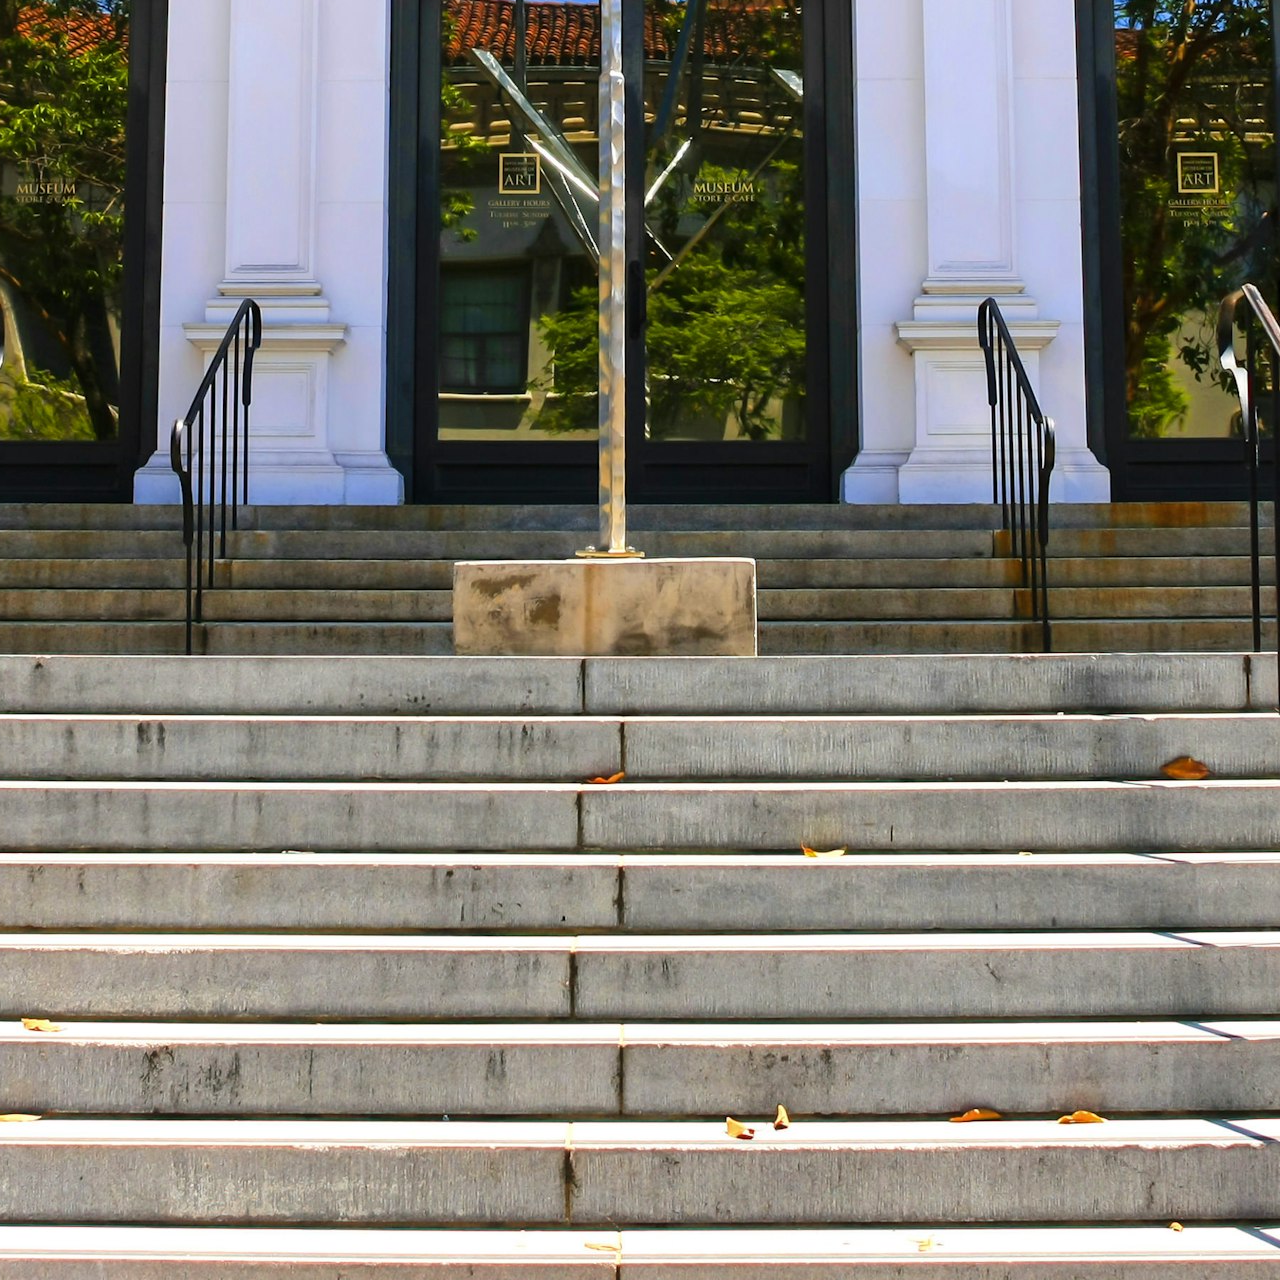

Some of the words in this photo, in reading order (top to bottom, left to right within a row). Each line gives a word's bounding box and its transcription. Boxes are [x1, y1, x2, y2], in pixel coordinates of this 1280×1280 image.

[504, 174, 535, 186] ART
[1183, 172, 1213, 186] ART
[16, 183, 76, 194] MUSEUM
[694, 183, 754, 194] MUSEUM
[693, 194, 720, 202] STORE
